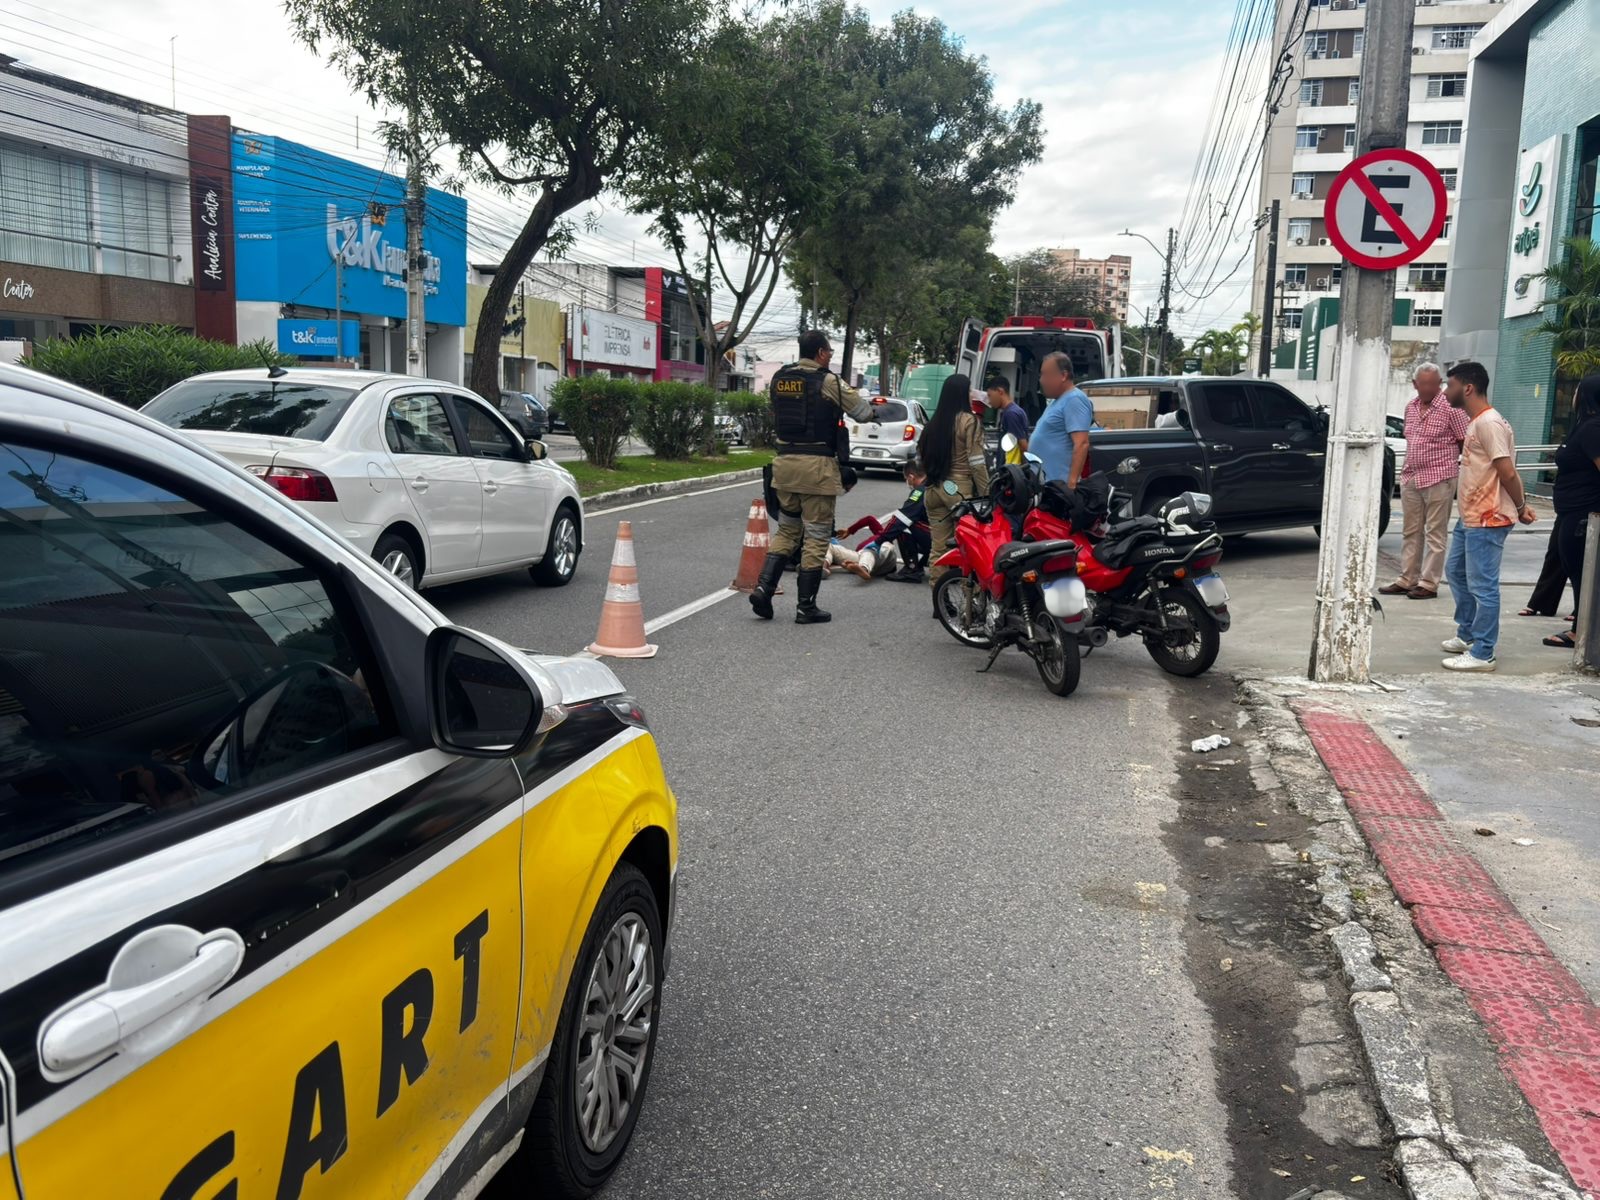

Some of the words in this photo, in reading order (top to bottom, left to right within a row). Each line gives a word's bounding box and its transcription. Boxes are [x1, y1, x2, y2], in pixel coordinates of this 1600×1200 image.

[201, 189, 219, 227] Center
[1360, 174, 1411, 245] E
[3, 277, 35, 300] Center
[291, 329, 314, 344] t&k
[603, 322, 632, 342] ELÉTRICA
[603, 341, 632, 358] IMPRENSA
[777, 381, 803, 392] GART
[1144, 547, 1175, 557] HONDA
